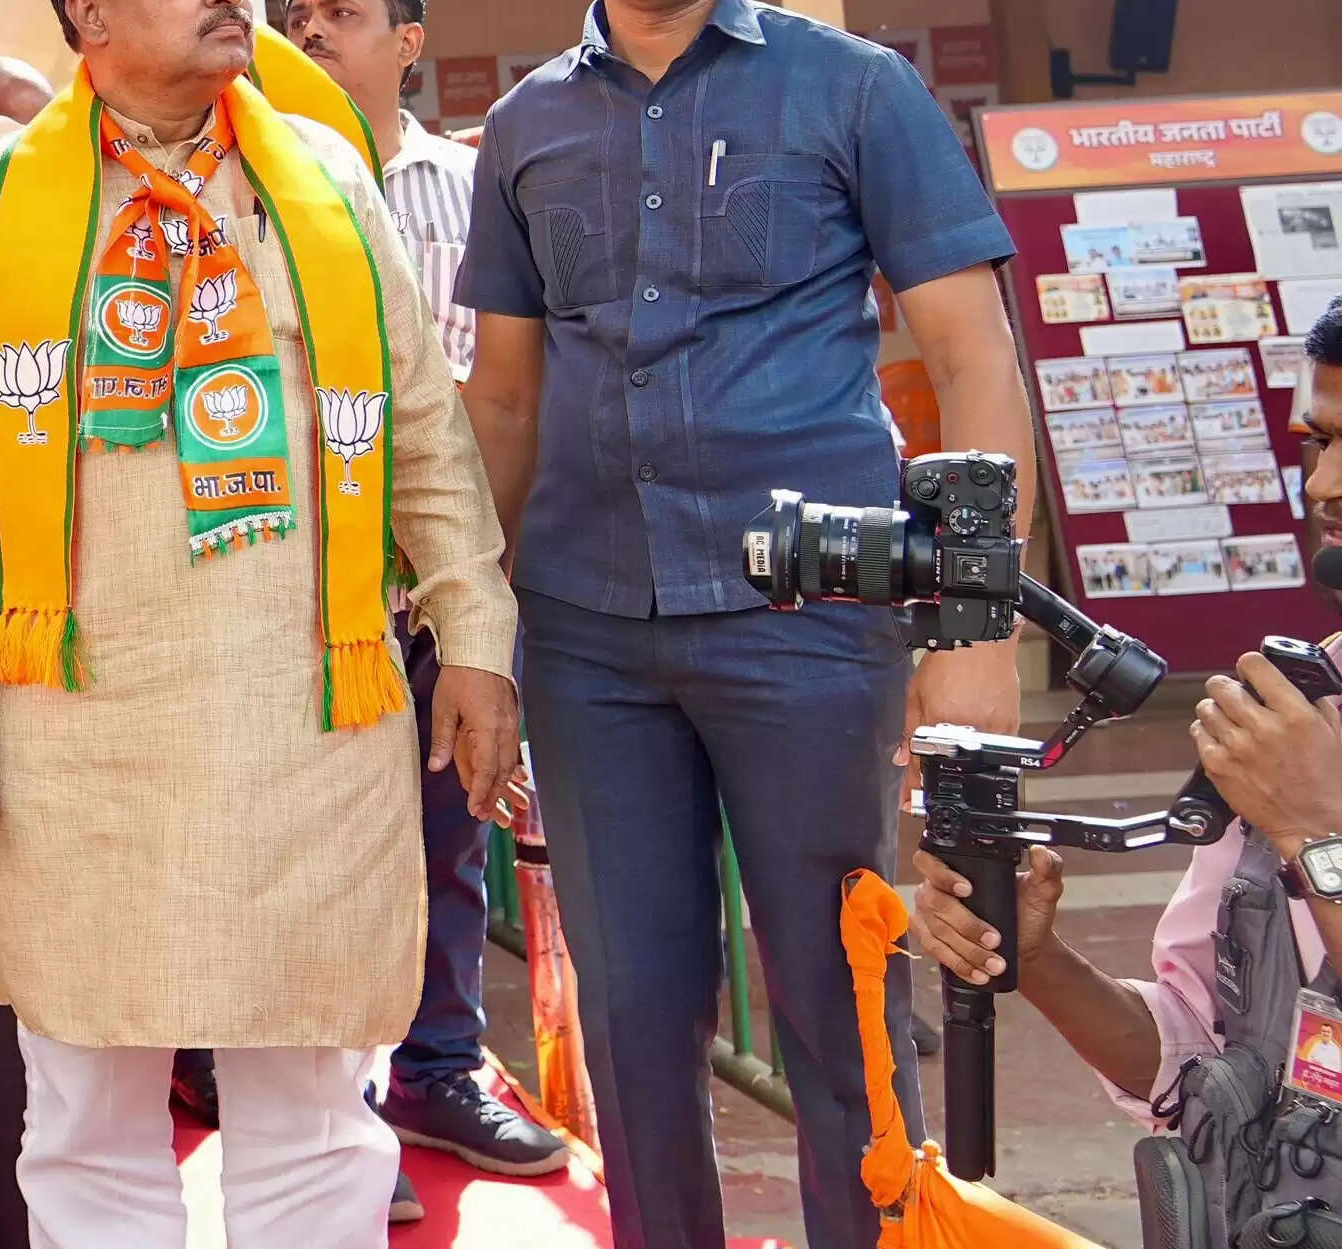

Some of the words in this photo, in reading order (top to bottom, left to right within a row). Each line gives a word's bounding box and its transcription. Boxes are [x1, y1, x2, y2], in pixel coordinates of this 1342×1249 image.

[1069, 120, 1156, 148] भारतीय
[1158, 119, 1226, 143] जनता
[1227, 109, 1284, 139] पार्टी
[192, 470, 283, 499] भा.ज.पा.
[934, 548, 943, 584] SONY
